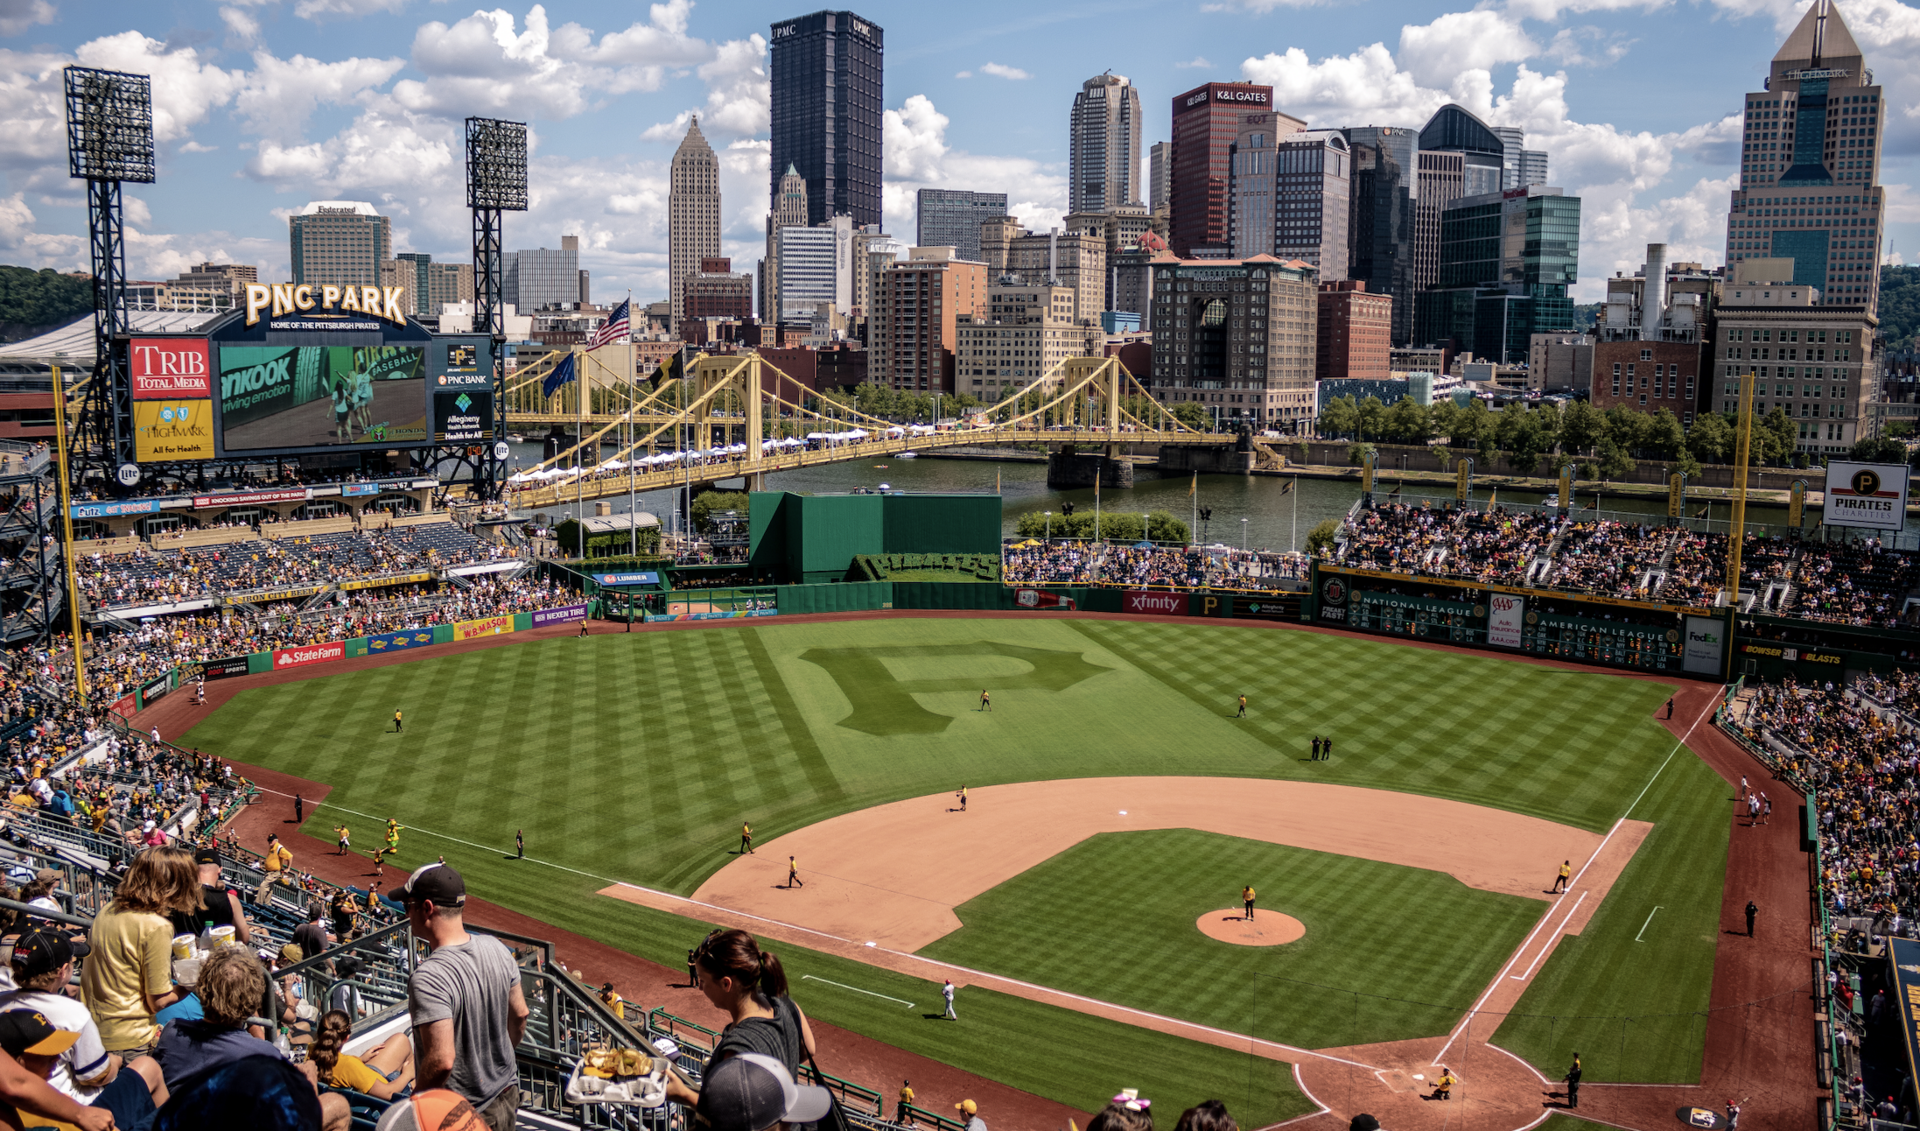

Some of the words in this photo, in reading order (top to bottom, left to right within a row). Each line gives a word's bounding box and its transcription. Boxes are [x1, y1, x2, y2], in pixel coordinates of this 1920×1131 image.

[772, 25, 796, 39] UPMC
[853, 20, 870, 37] UPMC
[1788, 69, 1848, 80] HIGHMARK
[1217, 91, 1234, 100] K&L
[1236, 92, 1266, 102] GATES
[1247, 114, 1268, 124] EQT
[245, 283, 316, 326] PNC
[322, 285, 407, 326] PARK
[135, 346, 204, 375] TRIB
[372, 353, 418, 376] BASEBALL
[138, 377, 172, 388] TOTAL
[174, 377, 206, 388] MEDIA
[447, 376, 464, 384] PNC
[465, 375, 487, 384] BANK
[251, 384, 291, 403] emotion
[447, 415, 480, 424] Allegheny
[147, 426, 206, 438] HIGHMARK
[445, 432, 464, 440] Health
[177, 444, 201, 452] Health
[496, 447, 507, 455] Lite
[121, 470, 137, 480] Lite
[1860, 475, 1872, 491] P
[1835, 498, 1892, 511] PIRATES
[1834, 509, 1891, 519] CHARITIES
[370, 578, 392, 586] LIGHT
[268, 591, 288, 599] CITY
[1132, 594, 1179, 612] xfinity
[1204, 597, 1218, 615] P
[1364, 597, 1421, 610] NATIONAL
[1426, 605, 1470, 616] LEAGUE
[1493, 598, 1512, 610] AAA
[547, 610, 569, 620] NEXEN
[570, 608, 585, 616] TIRE
[1321, 611, 1344, 620] FAST!
[464, 617, 507, 638] W.B.MASON
[1491, 625, 1520, 633] Insurance
[1540, 620, 1607, 633] AMERICAN
[1612, 628, 1663, 642] LEAGUE
[1491, 636, 1519, 644] AAA.com
[1690, 632, 1717, 643] FedEx
[1746, 645, 1782, 657] BOWSER
[1805, 653, 1840, 664] BLASTS
